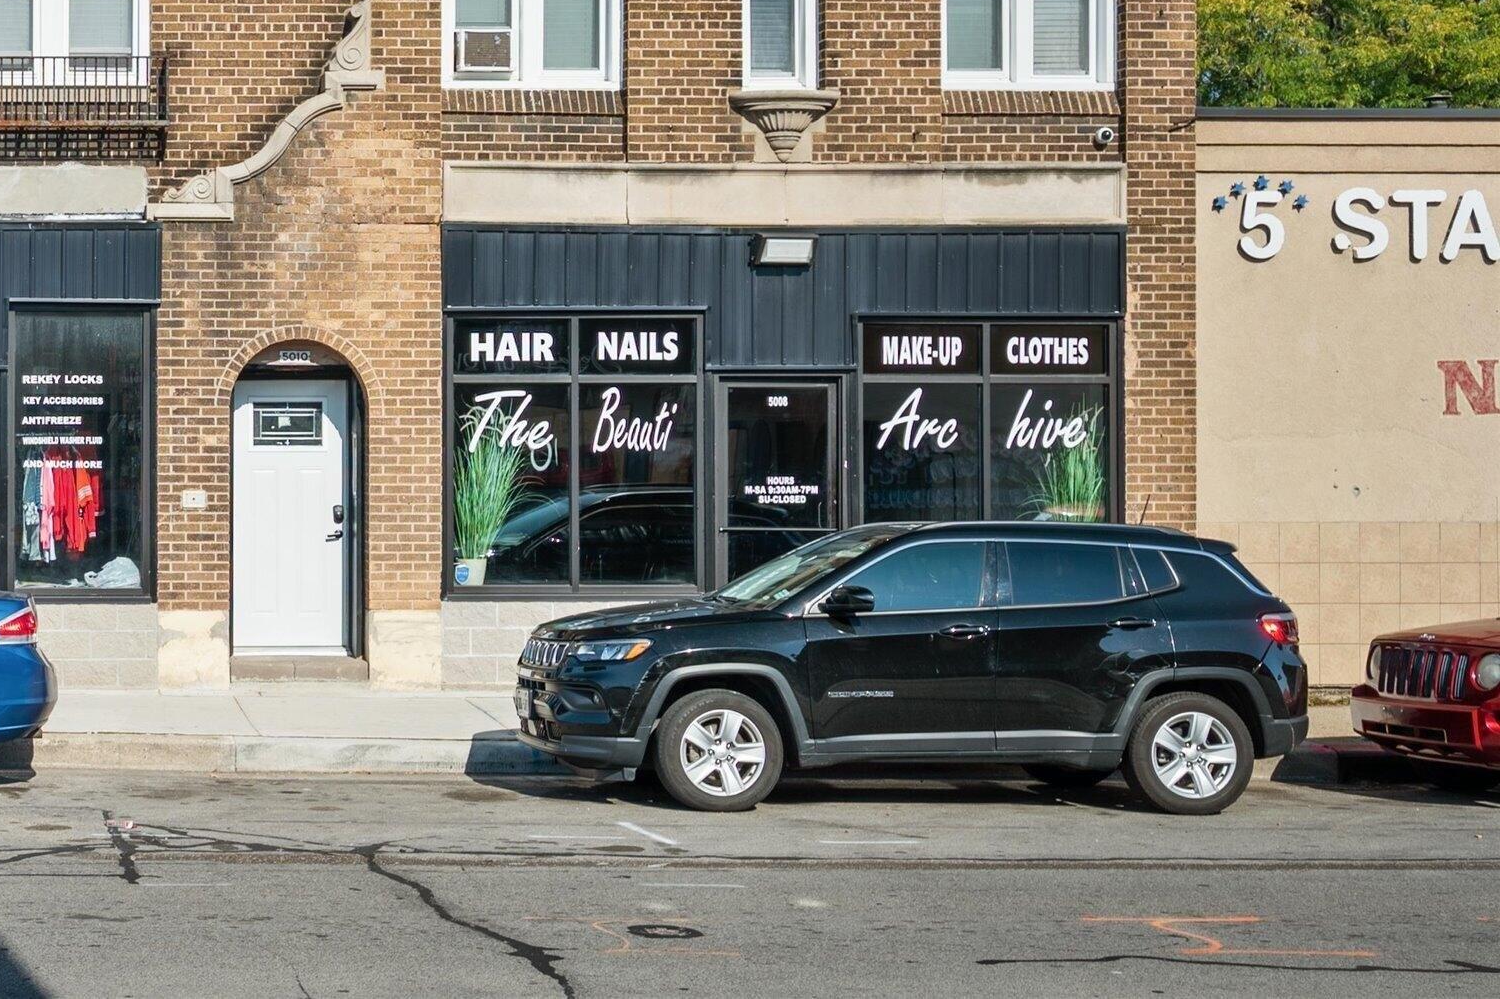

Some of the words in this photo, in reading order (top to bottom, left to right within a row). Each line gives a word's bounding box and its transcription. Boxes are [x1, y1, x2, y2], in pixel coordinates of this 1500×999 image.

[1237, 189, 1285, 262] 5
[1331, 187, 1500, 264] STA
[470, 332, 554, 362] HAIR
[598, 331, 679, 361] NAILS
[882, 336, 962, 366] MAKE-UP
[1006, 336, 1089, 365] CLOTHES
[282, 352, 309, 361] 5010
[22, 374, 61, 384] REKEY
[64, 375, 103, 384] LOCKS
[23, 397, 41, 405] KEY
[43, 397, 104, 405] ACCESSORIES
[768, 396, 789, 407] 5008
[22, 416, 82, 425] ANTIFREEZE
[469, 390, 554, 453] The
[593, 386, 678, 453] Beauti
[877, 387, 958, 451] Arc
[1006, 389, 1087, 449] hive
[22, 436, 59, 445] WINDSHIELD
[59, 436, 85, 445] WASHER
[86, 436, 103, 445] FLUID
[23, 460, 43, 468] AND
[45, 460, 73, 468] MUCH
[75, 460, 103, 469] MORE
[767, 476, 795, 485] HOURS
[744, 485, 767, 494] M-SA
[768, 485, 819, 495] 9:30AM-7PM
[758, 495, 807, 504] SU-CLOSED
